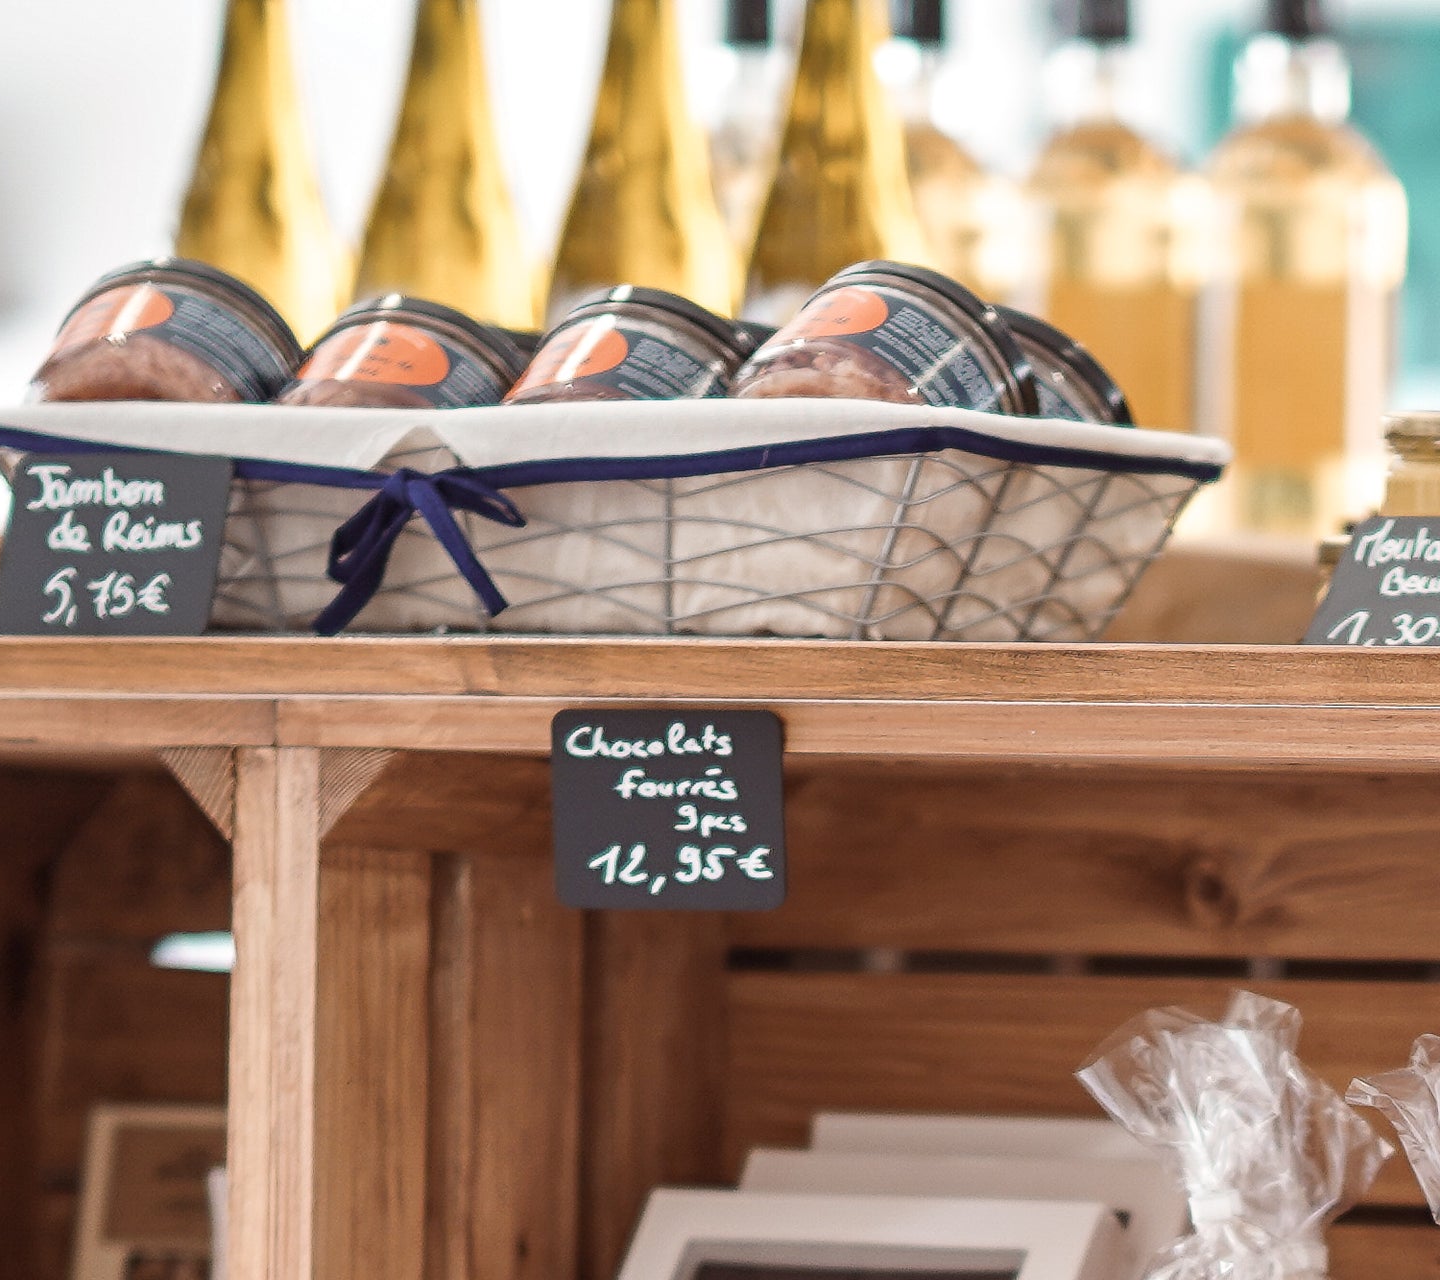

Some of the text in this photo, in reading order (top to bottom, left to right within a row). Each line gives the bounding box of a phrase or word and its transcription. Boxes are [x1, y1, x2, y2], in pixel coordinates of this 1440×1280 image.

[26, 464, 163, 511] Jambon
[48, 511, 202, 552] de Reims
[43, 566, 171, 627] 5,75€
[565, 722, 734, 758] Chocolats
[615, 767, 739, 800] fourrés
[588, 844, 775, 895] 12,95€
